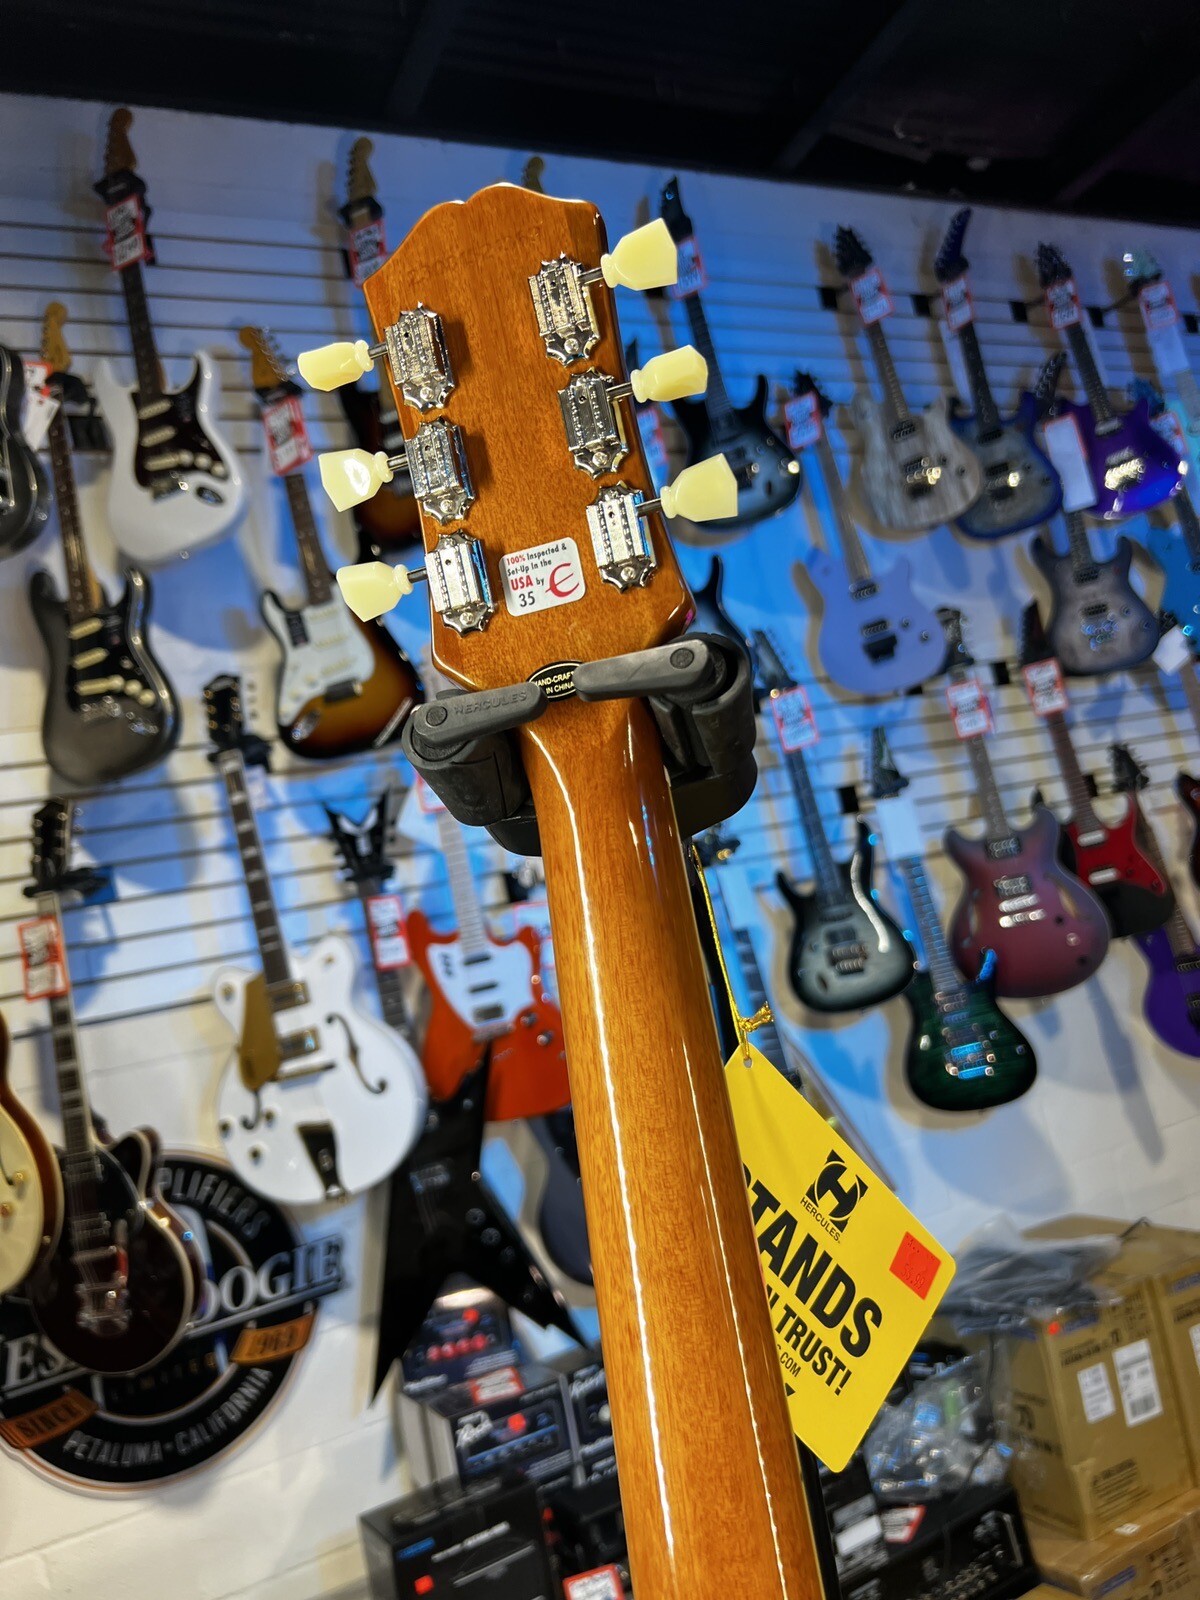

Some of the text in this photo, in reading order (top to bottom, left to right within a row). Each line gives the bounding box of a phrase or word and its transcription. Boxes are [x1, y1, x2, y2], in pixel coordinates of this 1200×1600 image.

[506, 543, 567, 566] 100% Inspected &
[507, 559, 552, 577] Set-Up In the
[510, 574, 534, 591] USA
[535, 577, 545, 586] by
[518, 591, 536, 607] 35
[546, 681, 575, 694] IN CHINA
[454, 691, 528, 715] HERCULES
[800, 1197, 841, 1243] HERCULES
[743, 1163, 882, 1358] TANDS
[775, 1303, 852, 1396] TRUST!
